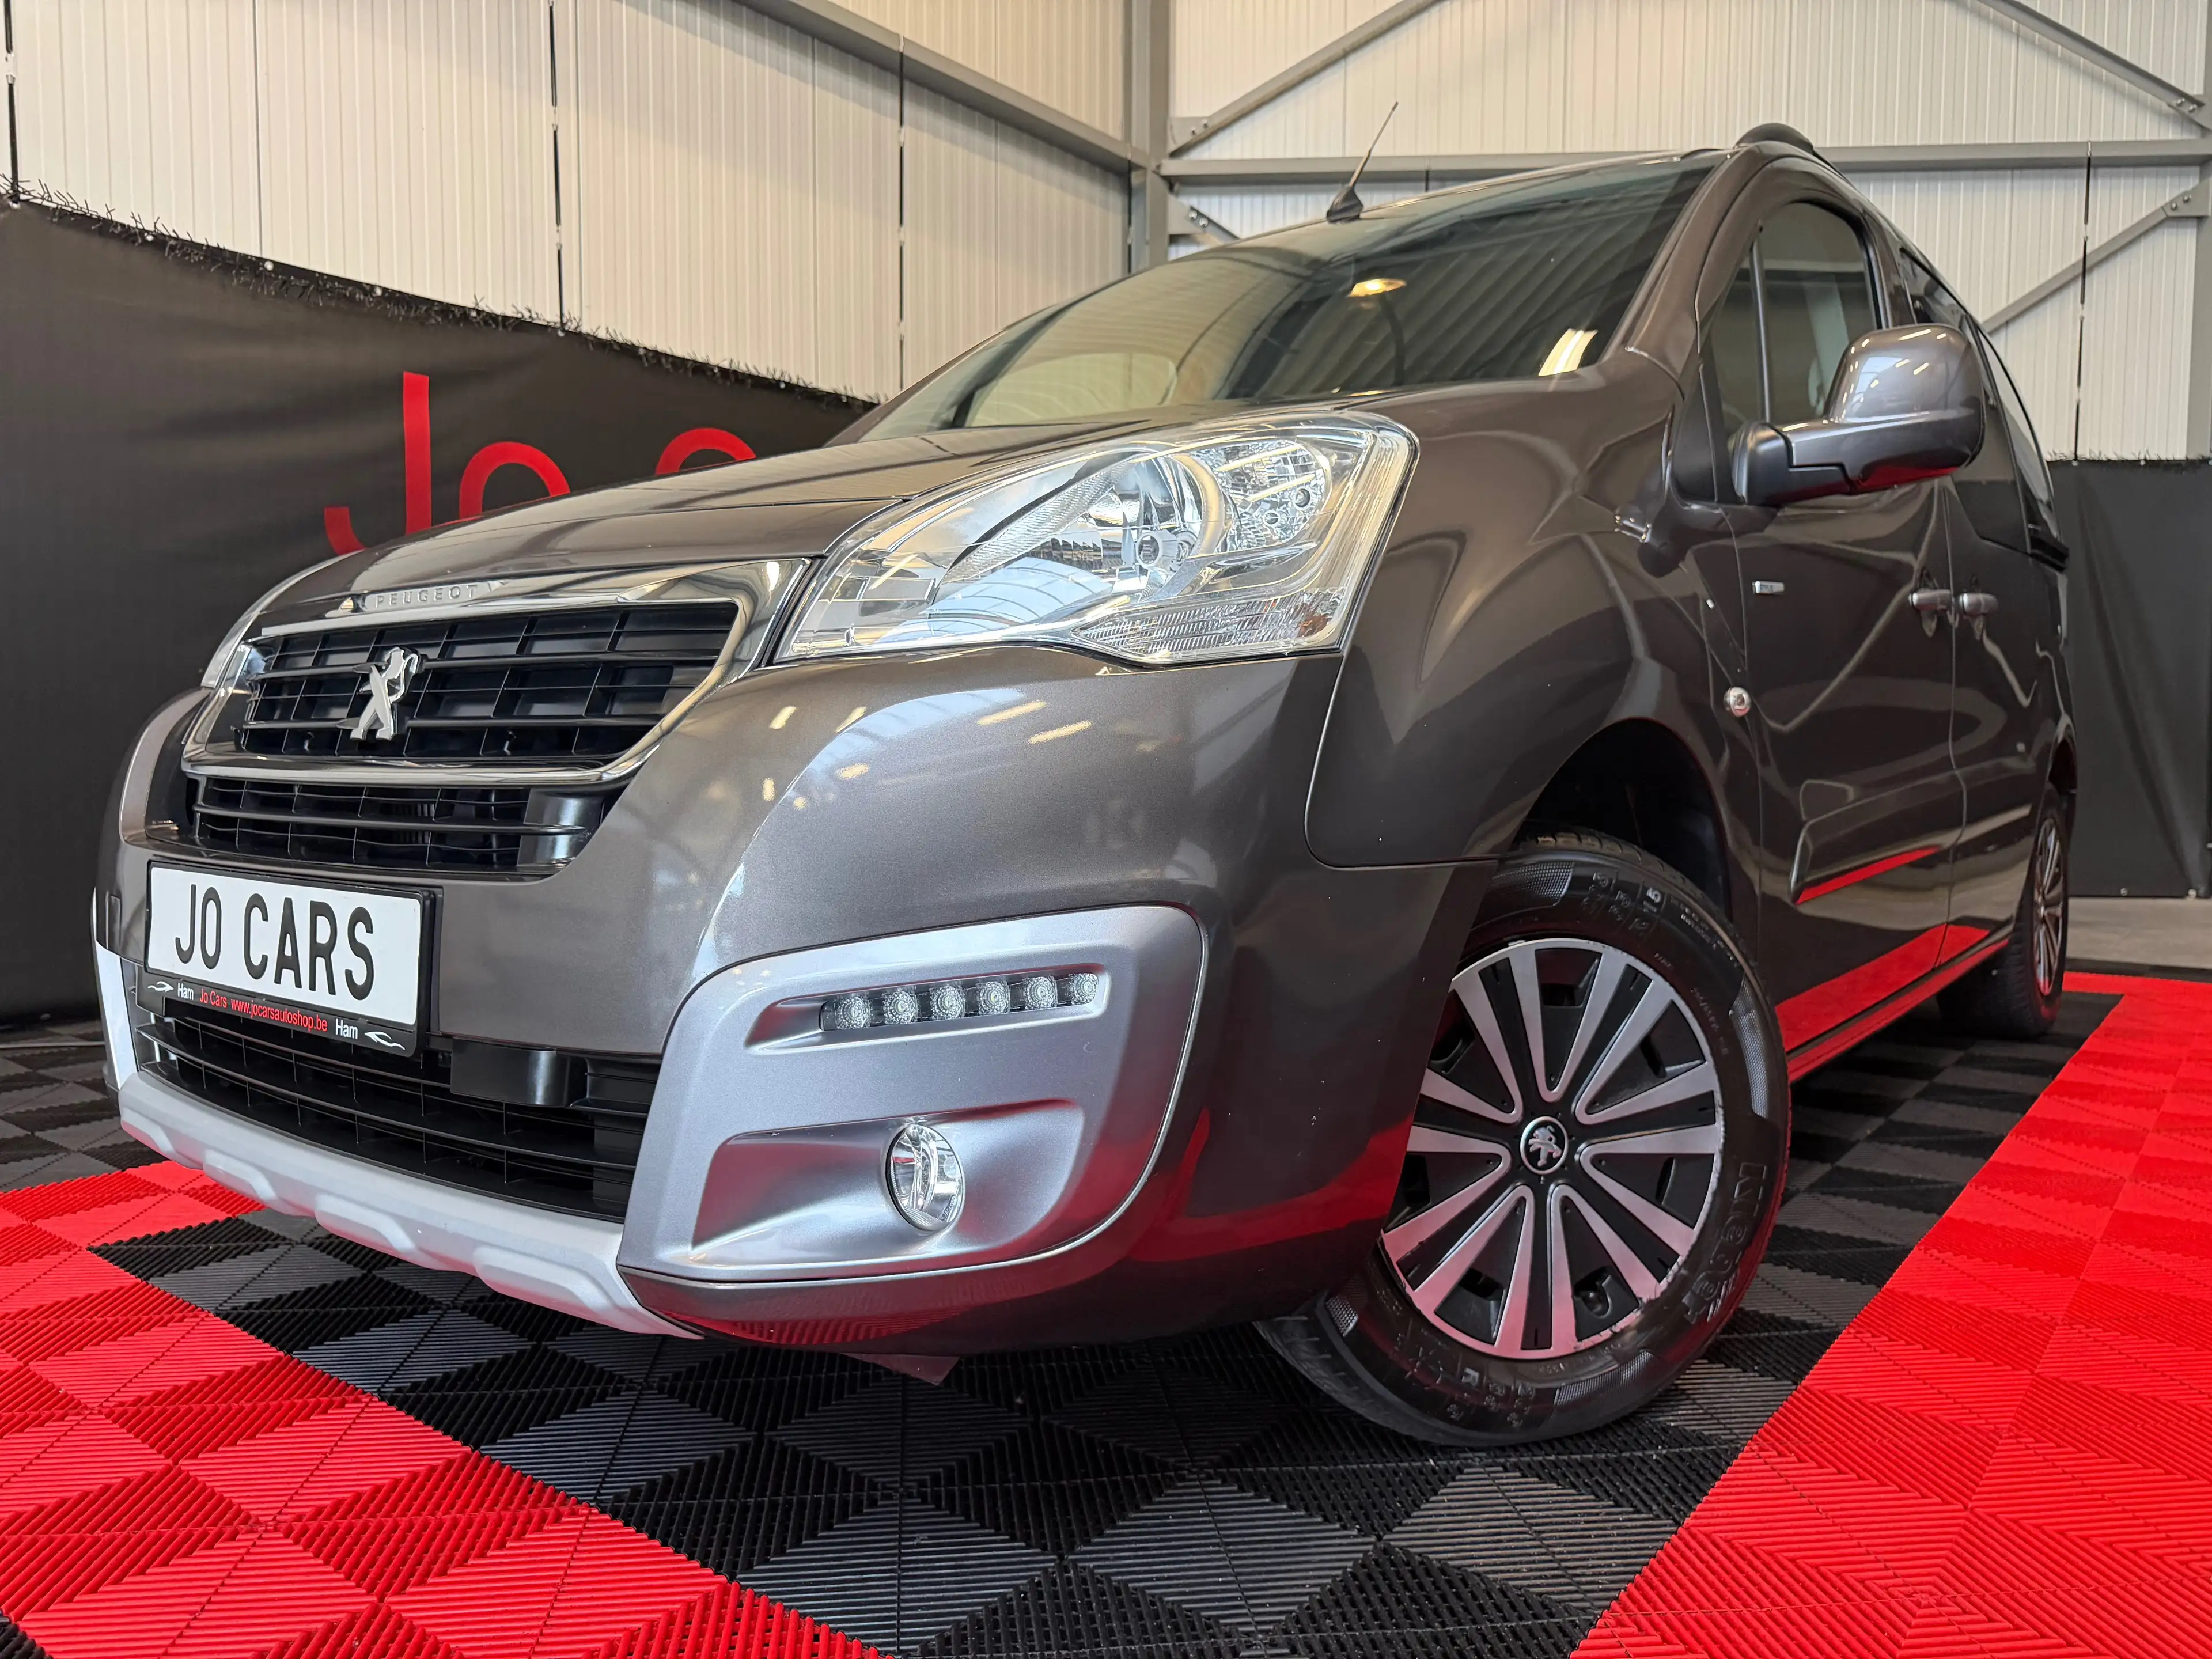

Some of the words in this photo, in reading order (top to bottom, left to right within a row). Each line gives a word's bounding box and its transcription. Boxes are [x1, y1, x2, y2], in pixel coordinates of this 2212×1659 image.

[375, 584, 478, 608] PEUGEOT
[175, 884, 222, 970] JO
[243, 893, 375, 1001] CARS
[177, 982, 195, 1001] Ham
[199, 988, 209, 1004] Jo
[209, 990, 228, 1009] Cars
[230, 997, 328, 1033] www.jocarsautoshop.be
[335, 1018, 359, 1040] Ham
